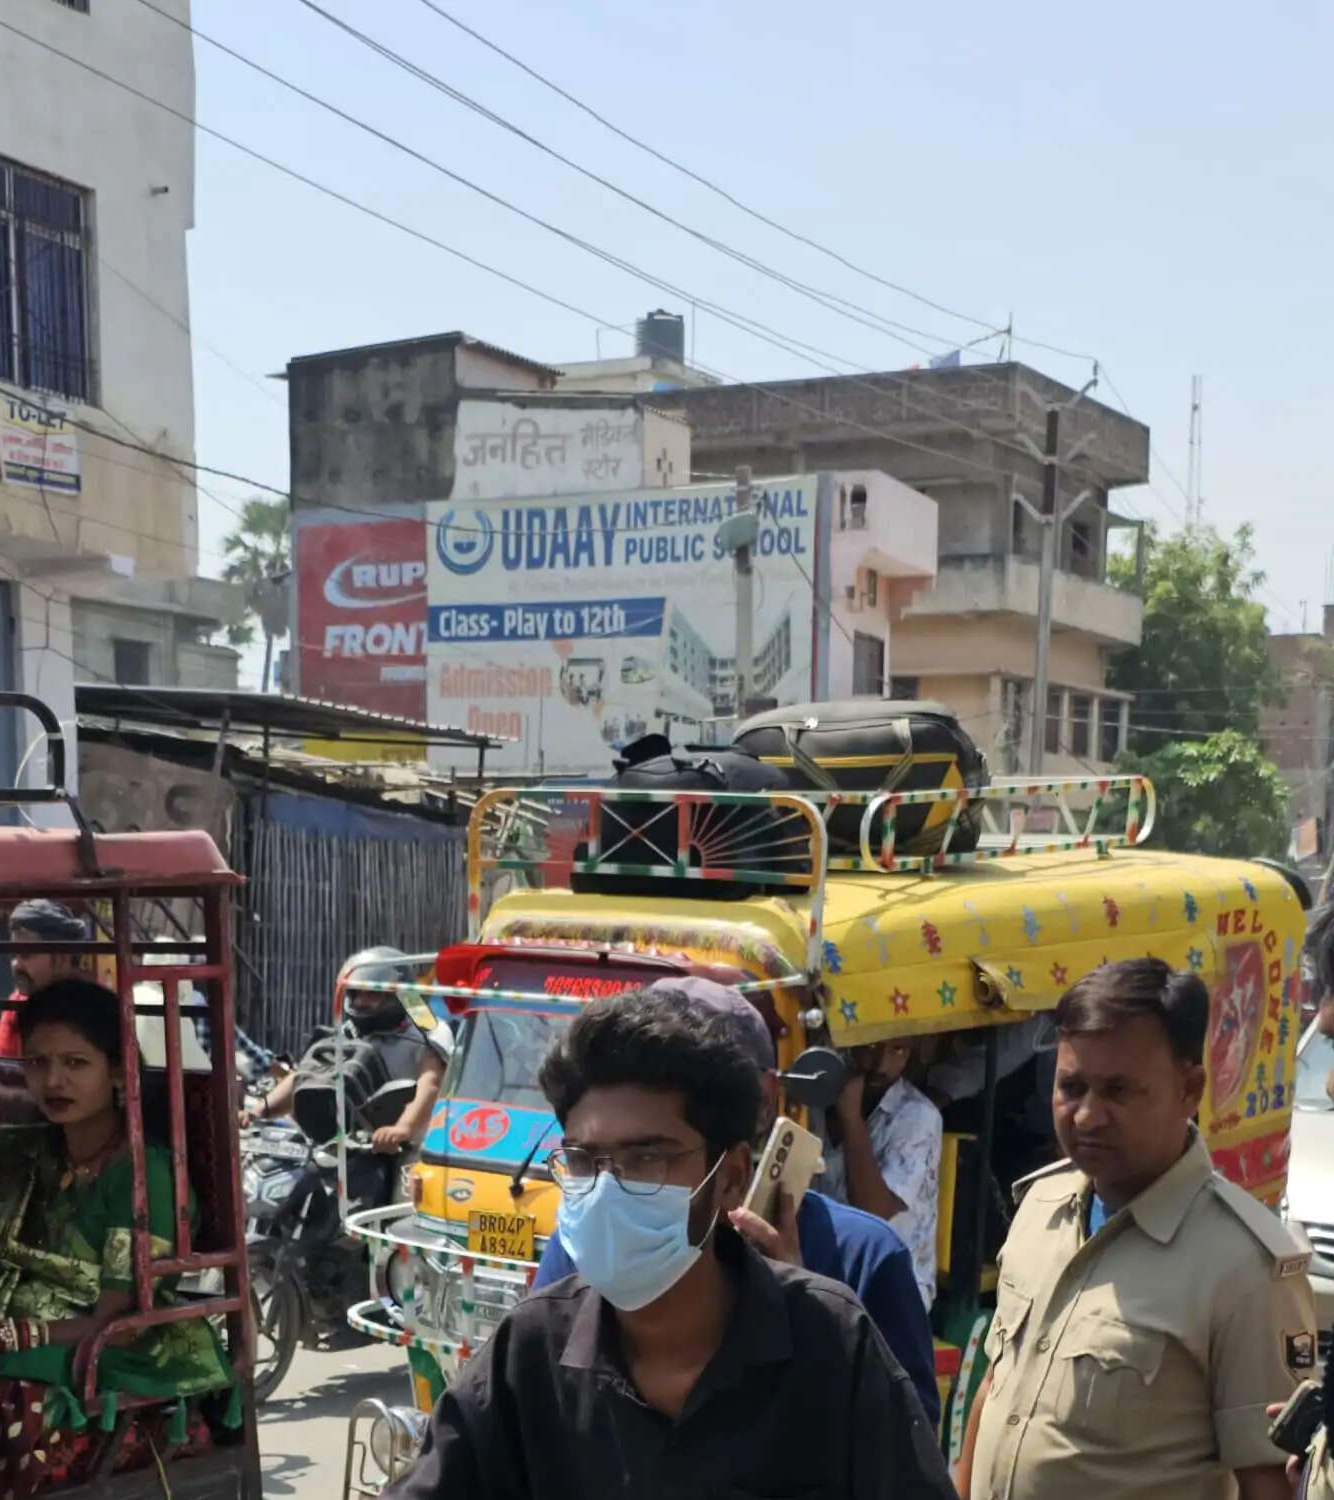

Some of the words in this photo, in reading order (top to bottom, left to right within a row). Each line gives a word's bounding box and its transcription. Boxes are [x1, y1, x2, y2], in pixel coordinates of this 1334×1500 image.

[6, 399, 67, 430] TO-LET
[462, 418, 573, 471] जनहित
[501, 502, 623, 571] UDAAY
[625, 489, 809, 530] INTERNATNAL
[624, 531, 704, 566] PUBLIC
[438, 608, 499, 638] Class-
[503, 607, 548, 641] Play
[552, 609, 575, 636] to
[579, 603, 627, 635] 12th
[439, 662, 553, 699] Admission
[467, 705, 523, 740] Open
[479, 1213, 526, 1235] BR04P
